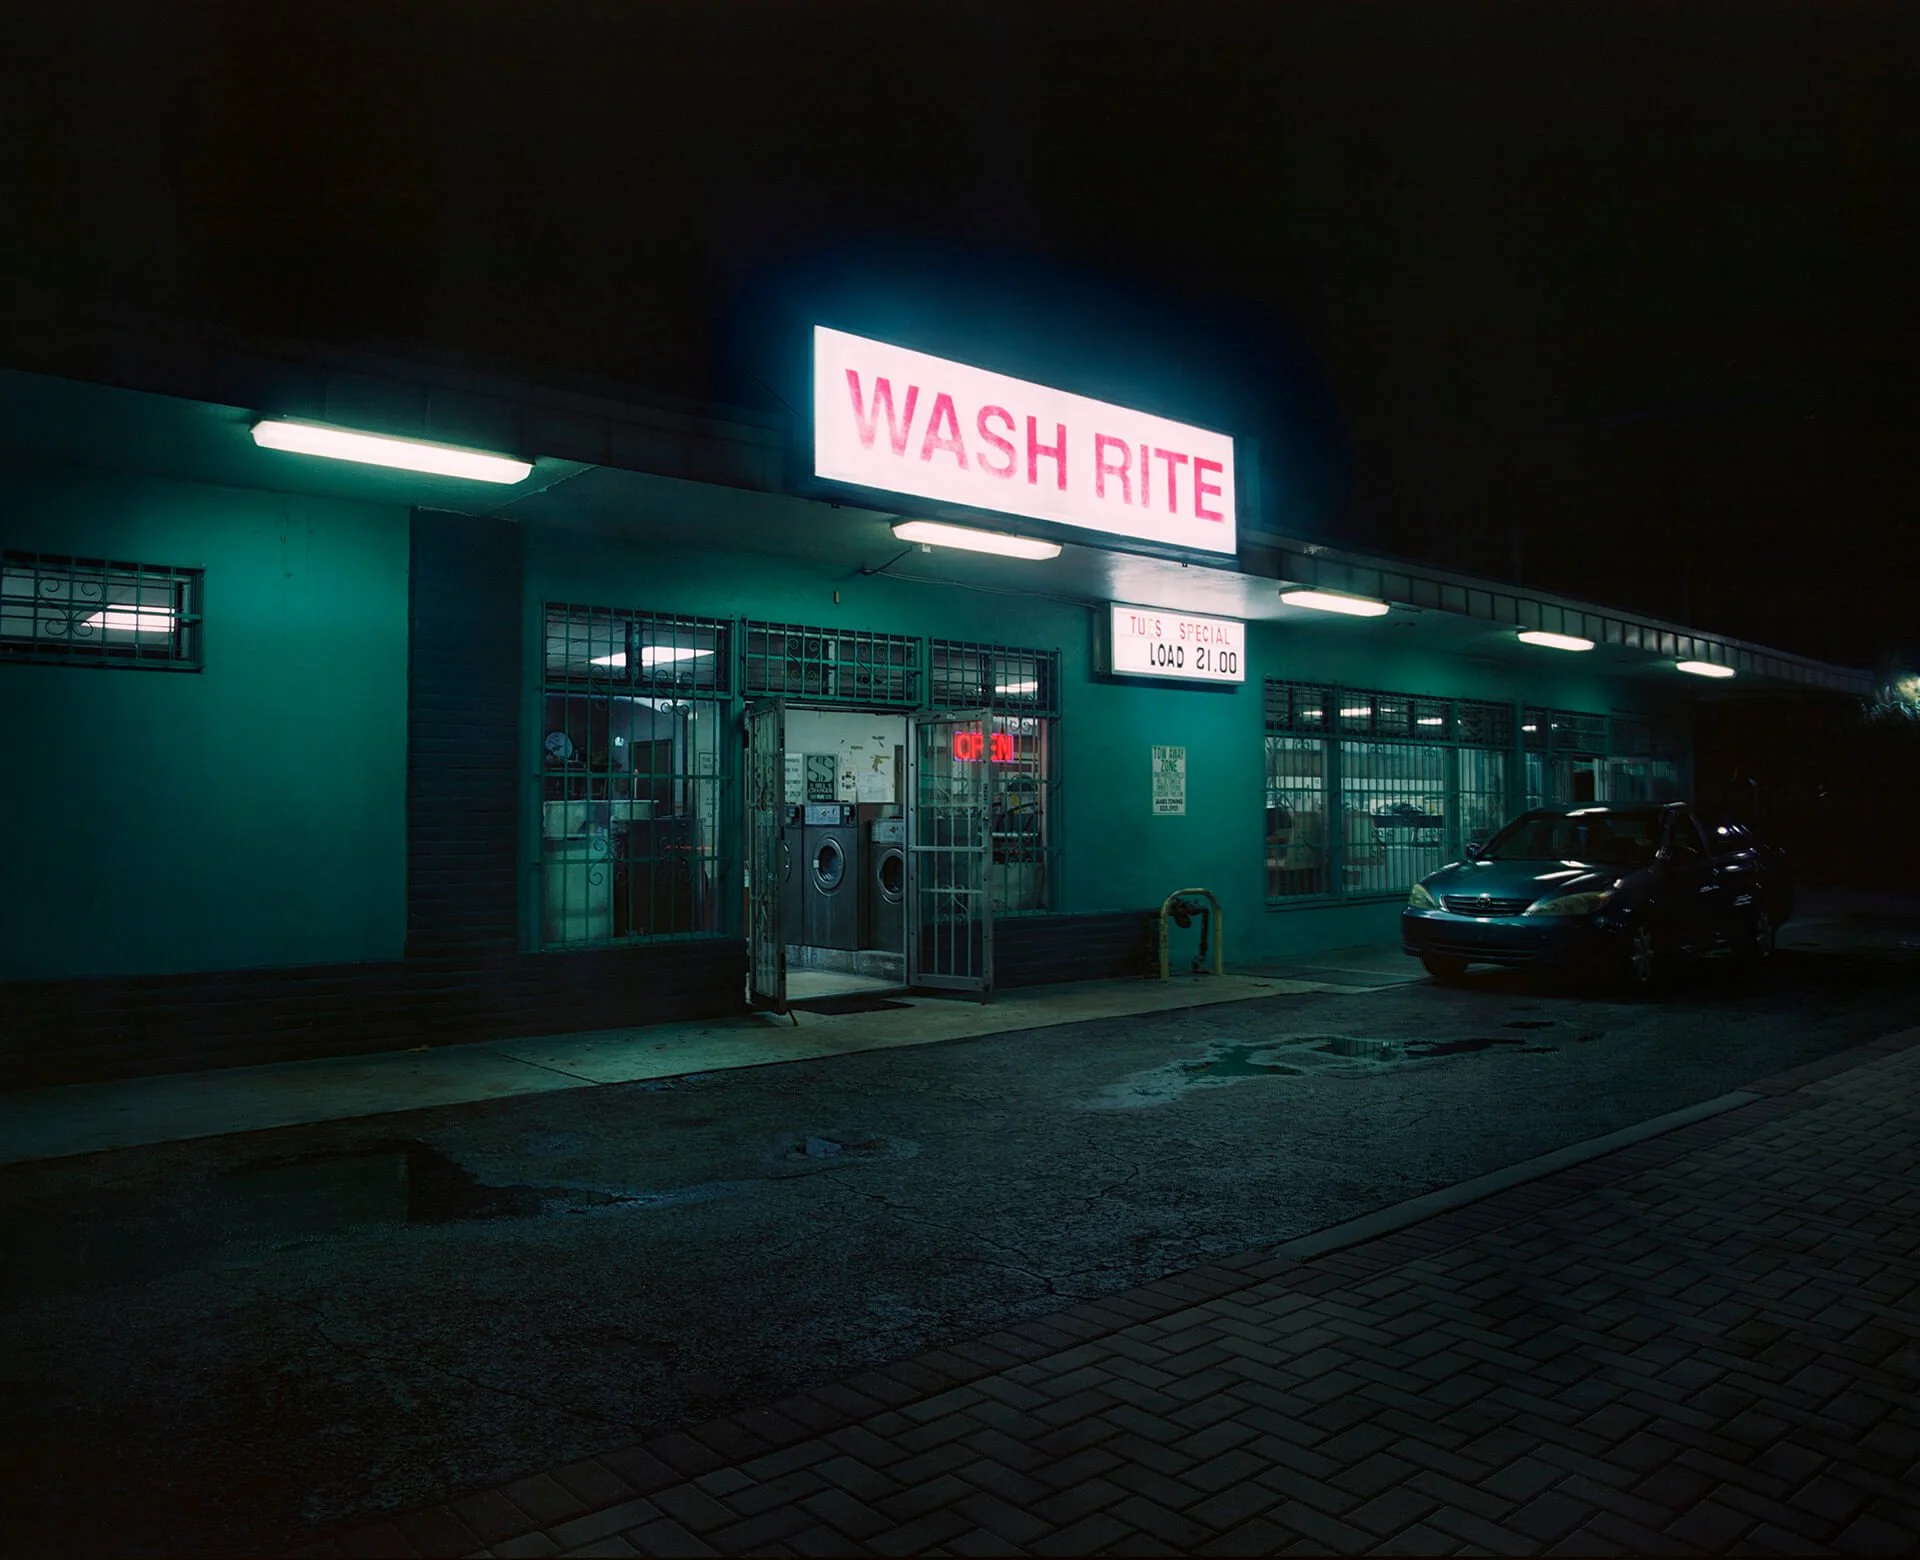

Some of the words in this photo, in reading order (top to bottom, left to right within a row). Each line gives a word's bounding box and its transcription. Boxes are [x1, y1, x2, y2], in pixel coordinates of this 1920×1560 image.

[845, 368, 1068, 491] WASH
[1095, 432, 1225, 523] RITE
[1130, 616, 1162, 638] TUS
[1179, 622, 1231, 645] SPECIAL
[1150, 642, 1185, 669] LOAD
[1161, 759, 1178, 772] ZONE
